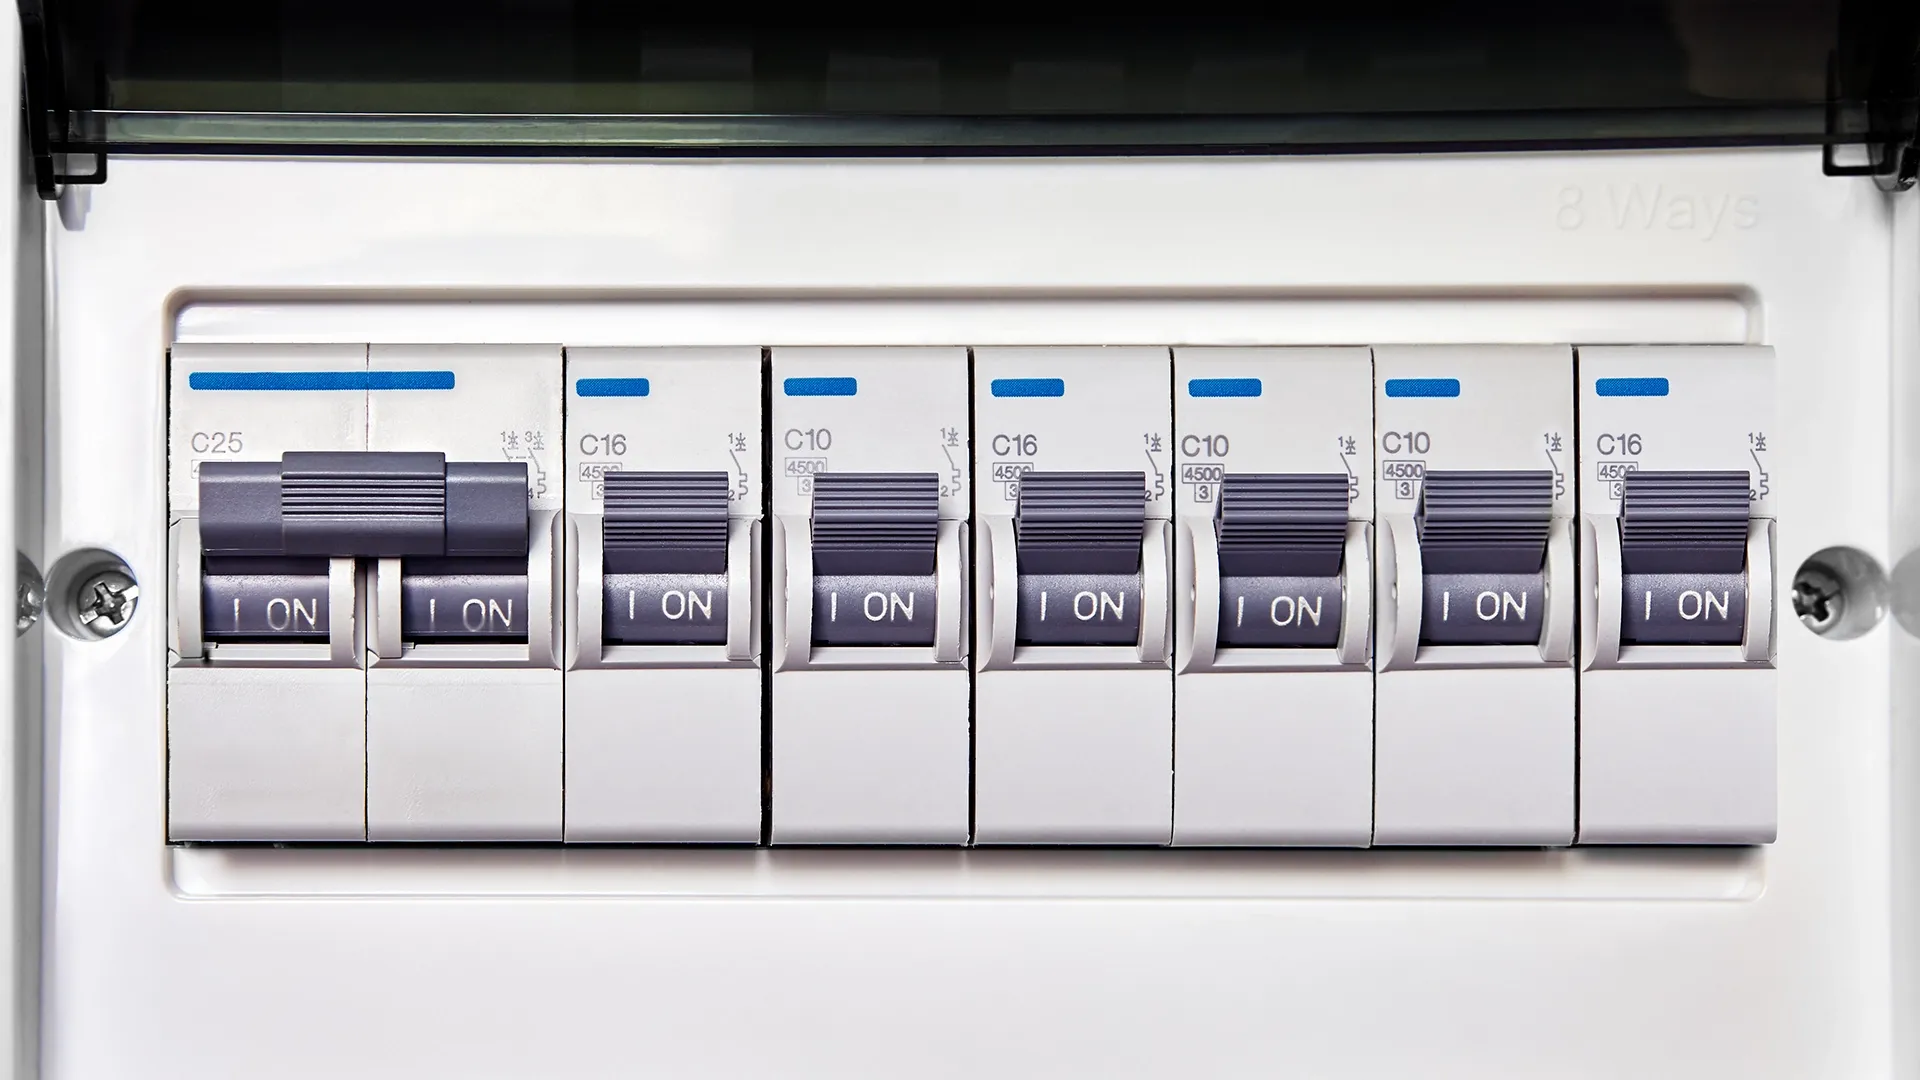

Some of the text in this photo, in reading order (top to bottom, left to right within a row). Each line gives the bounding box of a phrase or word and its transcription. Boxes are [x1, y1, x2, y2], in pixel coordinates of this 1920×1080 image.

[1556, 183, 1761, 242] 8 Ways
[191, 431, 244, 454] C25
[579, 433, 627, 456] C16
[784, 428, 832, 451] C10
[992, 434, 1038, 457] C16
[1181, 434, 1230, 458] C10
[1382, 431, 1431, 454] C10
[1597, 433, 1643, 456] C16
[1184, 466, 1223, 482] 4500
[1385, 463, 1424, 478] 4500
[940, 485, 949, 498] 2
[1199, 484, 1210, 500] 3
[1399, 481, 1411, 497] 3
[266, 598, 317, 631] ON
[462, 598, 513, 632] ON
[661, 590, 712, 620] ON
[863, 591, 915, 622] ON
[1073, 591, 1125, 621] ON
[1270, 595, 1322, 627] ON
[1476, 591, 1527, 621] ON
[1678, 590, 1729, 620] ON
